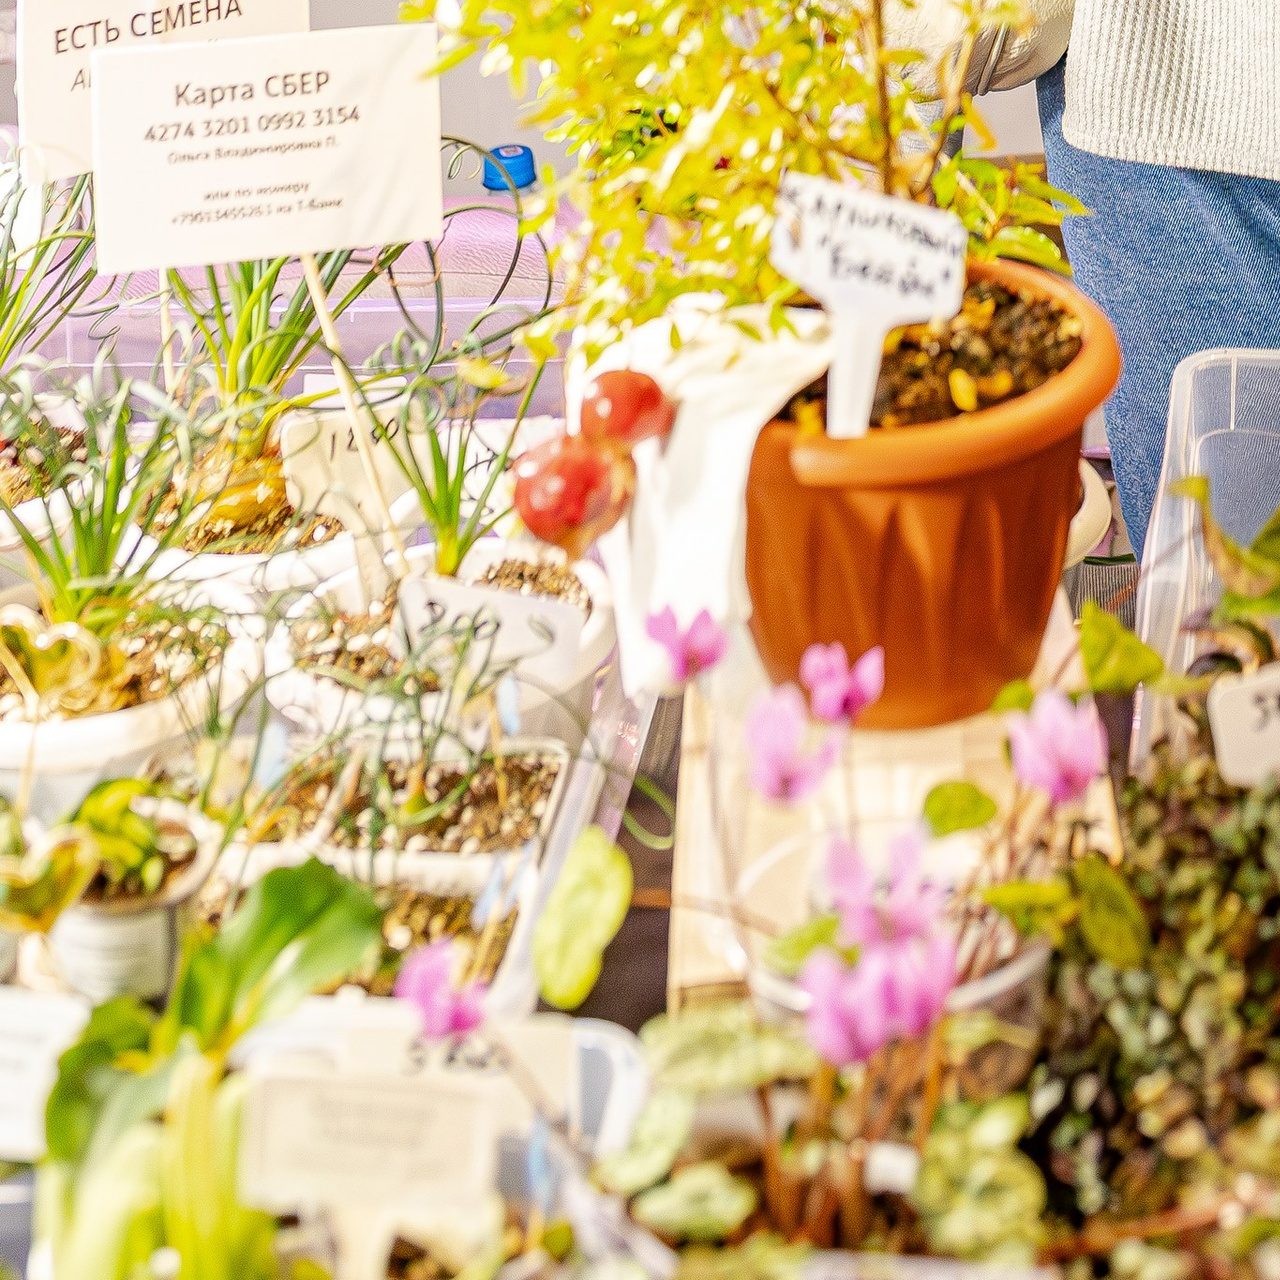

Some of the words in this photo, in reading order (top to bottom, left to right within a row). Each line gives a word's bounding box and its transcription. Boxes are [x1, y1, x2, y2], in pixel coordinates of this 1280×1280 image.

[54, 18, 120, 55] ЕСТЬ
[173, 81, 255, 109] Карта
[264, 70, 330, 98] СБЕР
[143, 122, 195, 142] 4274
[202, 116, 252, 138] 3201
[257, 110, 306, 133] 0992
[312, 105, 361, 127] 3154
[167, 151, 210, 164] Ольга
